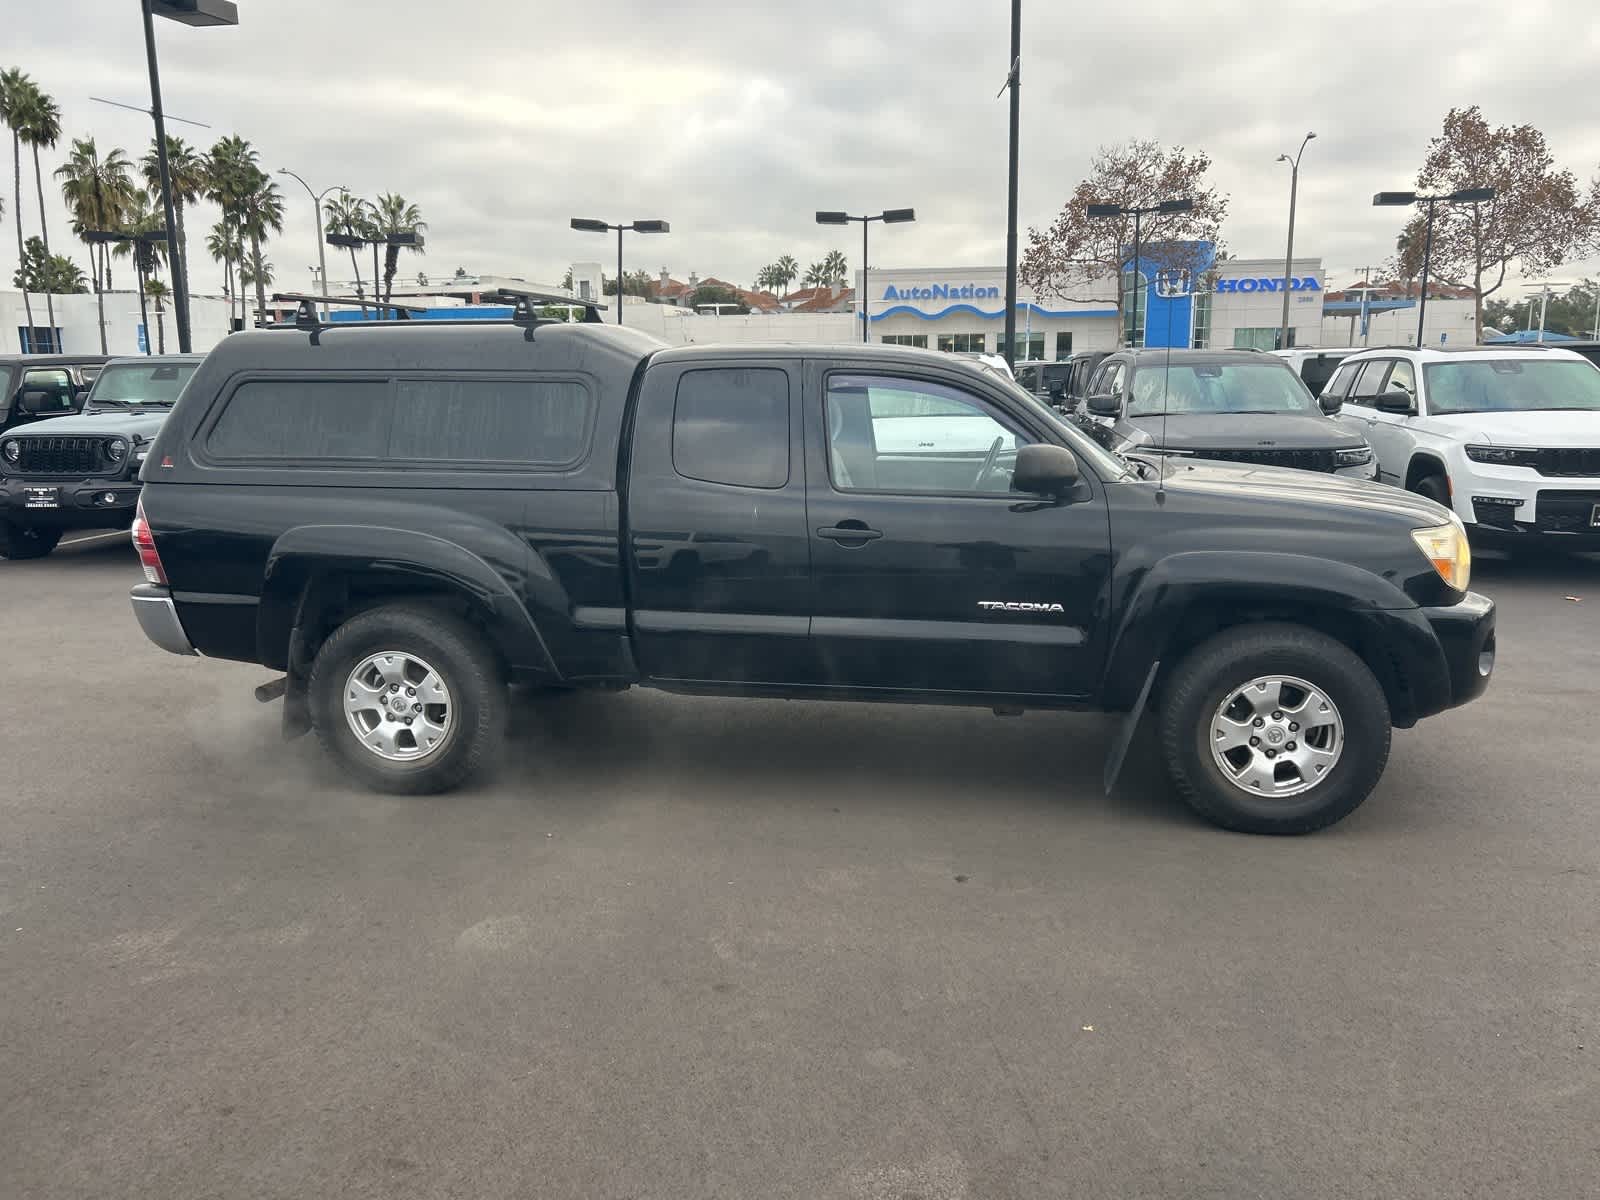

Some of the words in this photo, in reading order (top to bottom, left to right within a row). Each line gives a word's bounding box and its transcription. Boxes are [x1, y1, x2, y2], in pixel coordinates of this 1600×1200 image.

[883, 283, 999, 300] AutoNation
[1216, 277, 1322, 293] HONDA
[977, 601, 1065, 612] TACOMA
